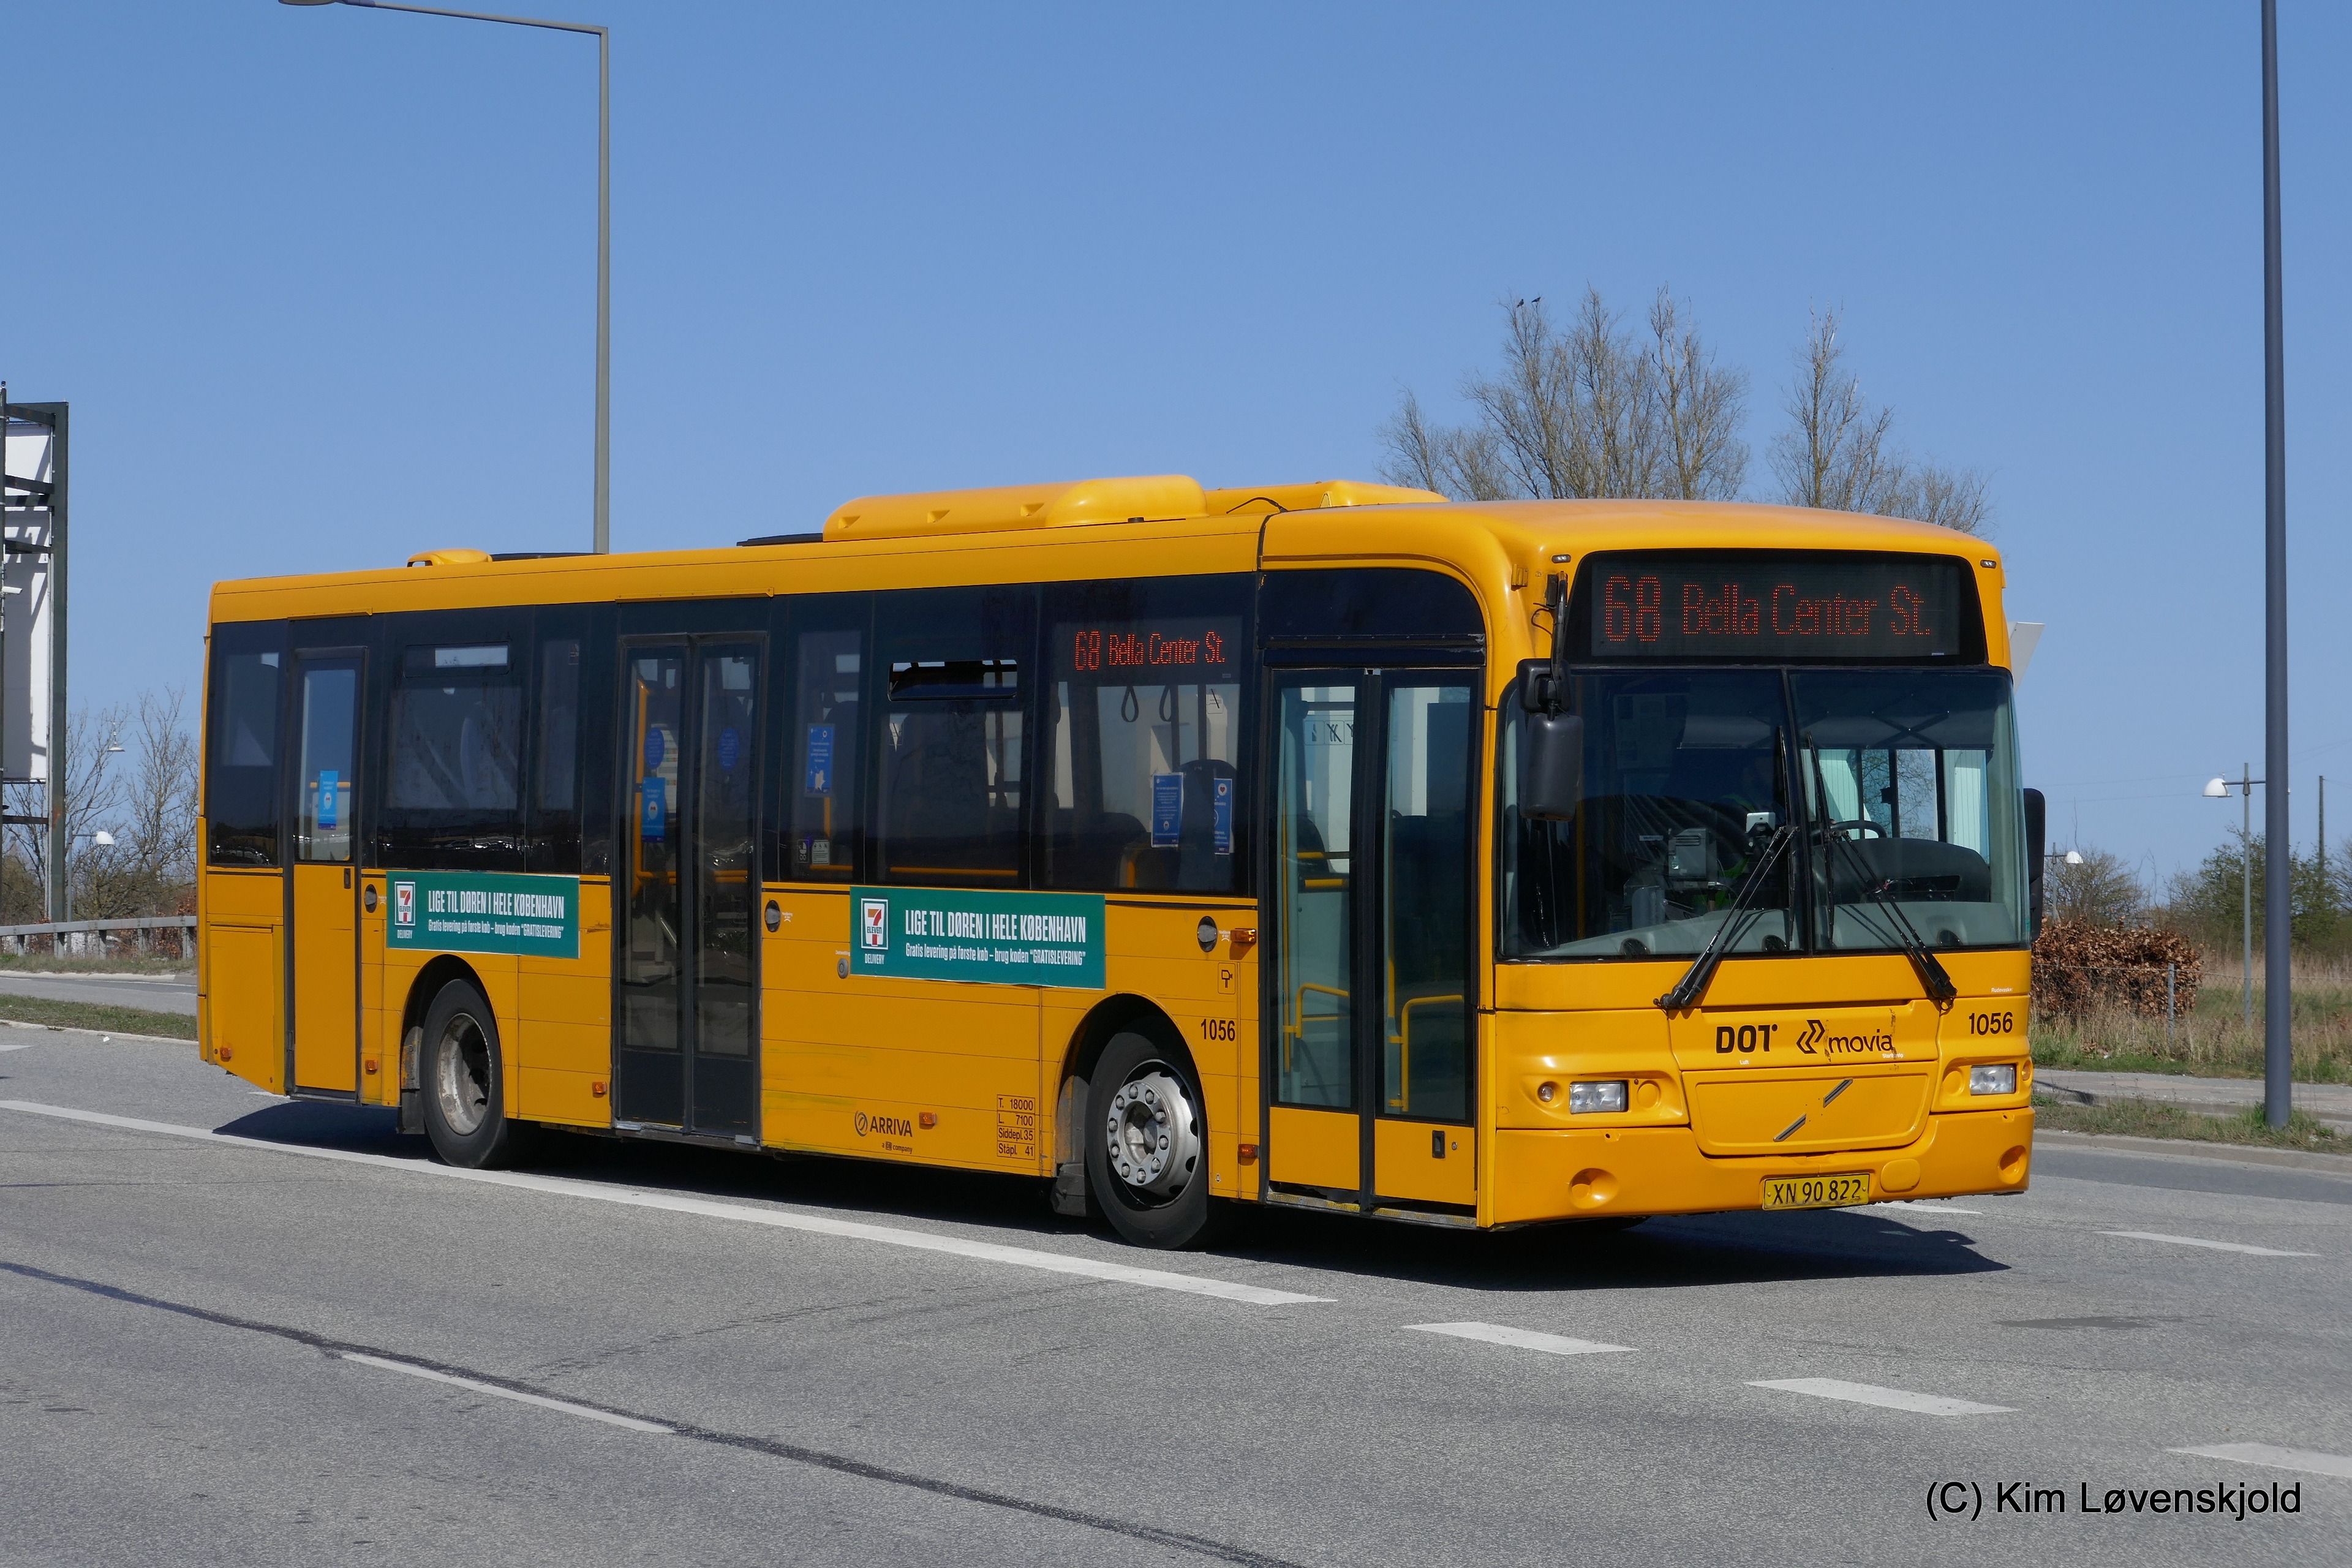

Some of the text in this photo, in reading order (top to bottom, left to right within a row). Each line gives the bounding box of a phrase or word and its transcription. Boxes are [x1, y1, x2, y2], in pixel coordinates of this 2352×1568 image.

[1605, 576, 1931, 641] 68 Bella Center St.
[1075, 631, 1226, 670] 68 Bella Center St.
[429, 890, 564, 919] LIGE TIL DØREN I HELE KØBENHAVN
[398, 930, 413, 939] DELIVERY
[429, 919, 442, 932] Gratis
[442, 920, 461, 934] levering
[461, 921, 467, 934] på
[495, 923, 505, 937] brug
[506, 923, 520, 936] koden
[905, 910, 1086, 943] LIGE TIL DØREN I HELE KØBENHAVN
[865, 954, 884, 965] DELIVERY
[906, 943, 923, 957] Gratis
[924, 943, 948, 961] levering
[949, 946, 957, 961] på
[958, 946, 976, 961] første
[977, 947, 988, 962] køb
[995, 948, 1009, 964] brug
[1010, 948, 1029, 963] koden
[1200, 1019, 1235, 1041] 1056
[1969, 1011, 2013, 1036] 1056
[1716, 1024, 1772, 1054] DOT
[1828, 1029, 1893, 1053] movia
[998, 1098, 1033, 1110] T. 18000
[869, 1116, 913, 1137] ARRIVA
[998, 1114, 1033, 1126] L. 7100
[998, 1128, 1033, 1142] Siddepl. 35
[892, 1145, 913, 1155] company
[998, 1143, 1033, 1156] Ståpl. 41
[1773, 1179, 1861, 1205] XN 90 822
